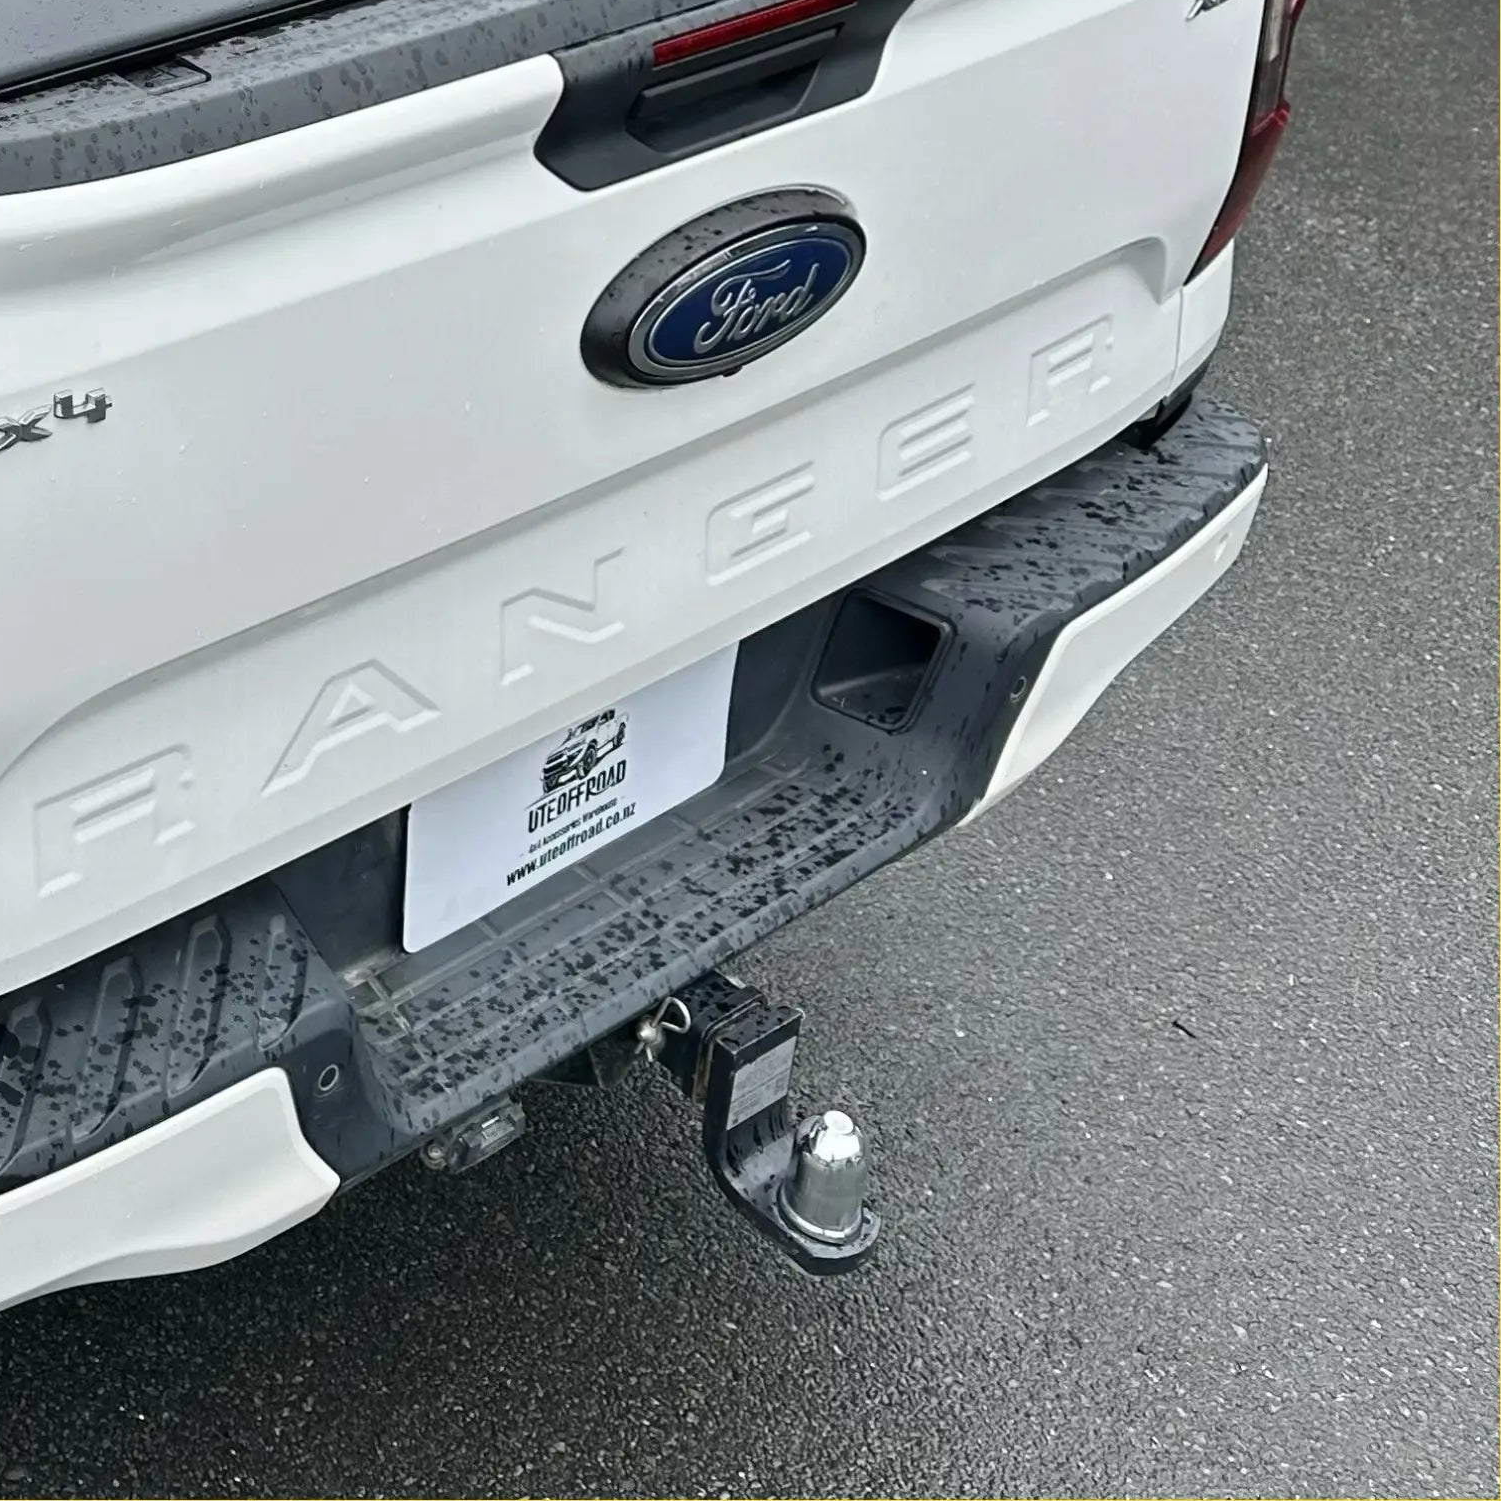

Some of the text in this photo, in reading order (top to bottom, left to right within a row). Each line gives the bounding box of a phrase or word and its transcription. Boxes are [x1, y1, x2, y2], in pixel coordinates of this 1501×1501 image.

[694, 259, 819, 354] Ford
[33, 313, 1115, 897] RANGER
[506, 802, 636, 886] www.uteoffroad.co.nz
